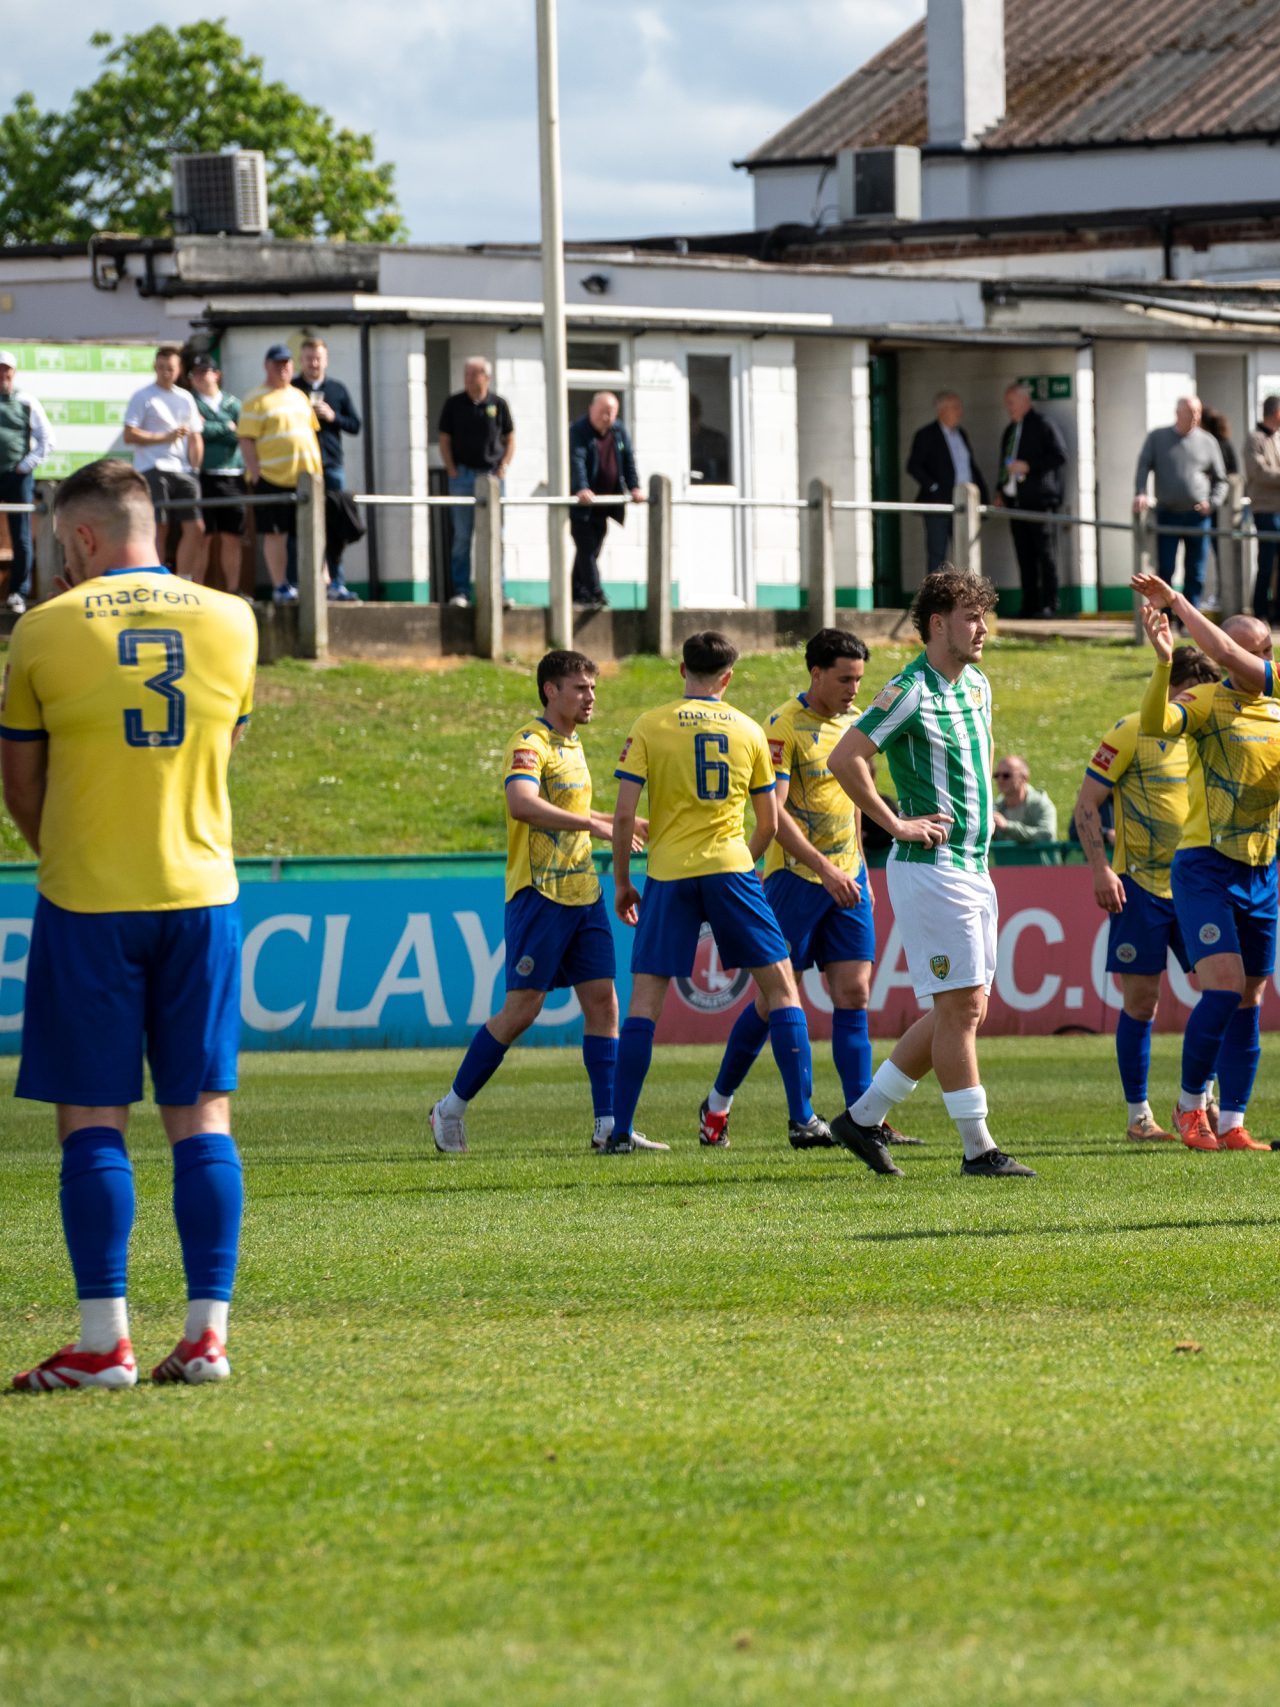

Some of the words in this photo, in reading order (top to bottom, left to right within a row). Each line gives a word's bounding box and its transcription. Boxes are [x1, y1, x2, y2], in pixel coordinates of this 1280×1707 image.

[85, 588, 201, 608] macron
[117, 628, 186, 748] 3
[694, 732, 730, 800] 6
